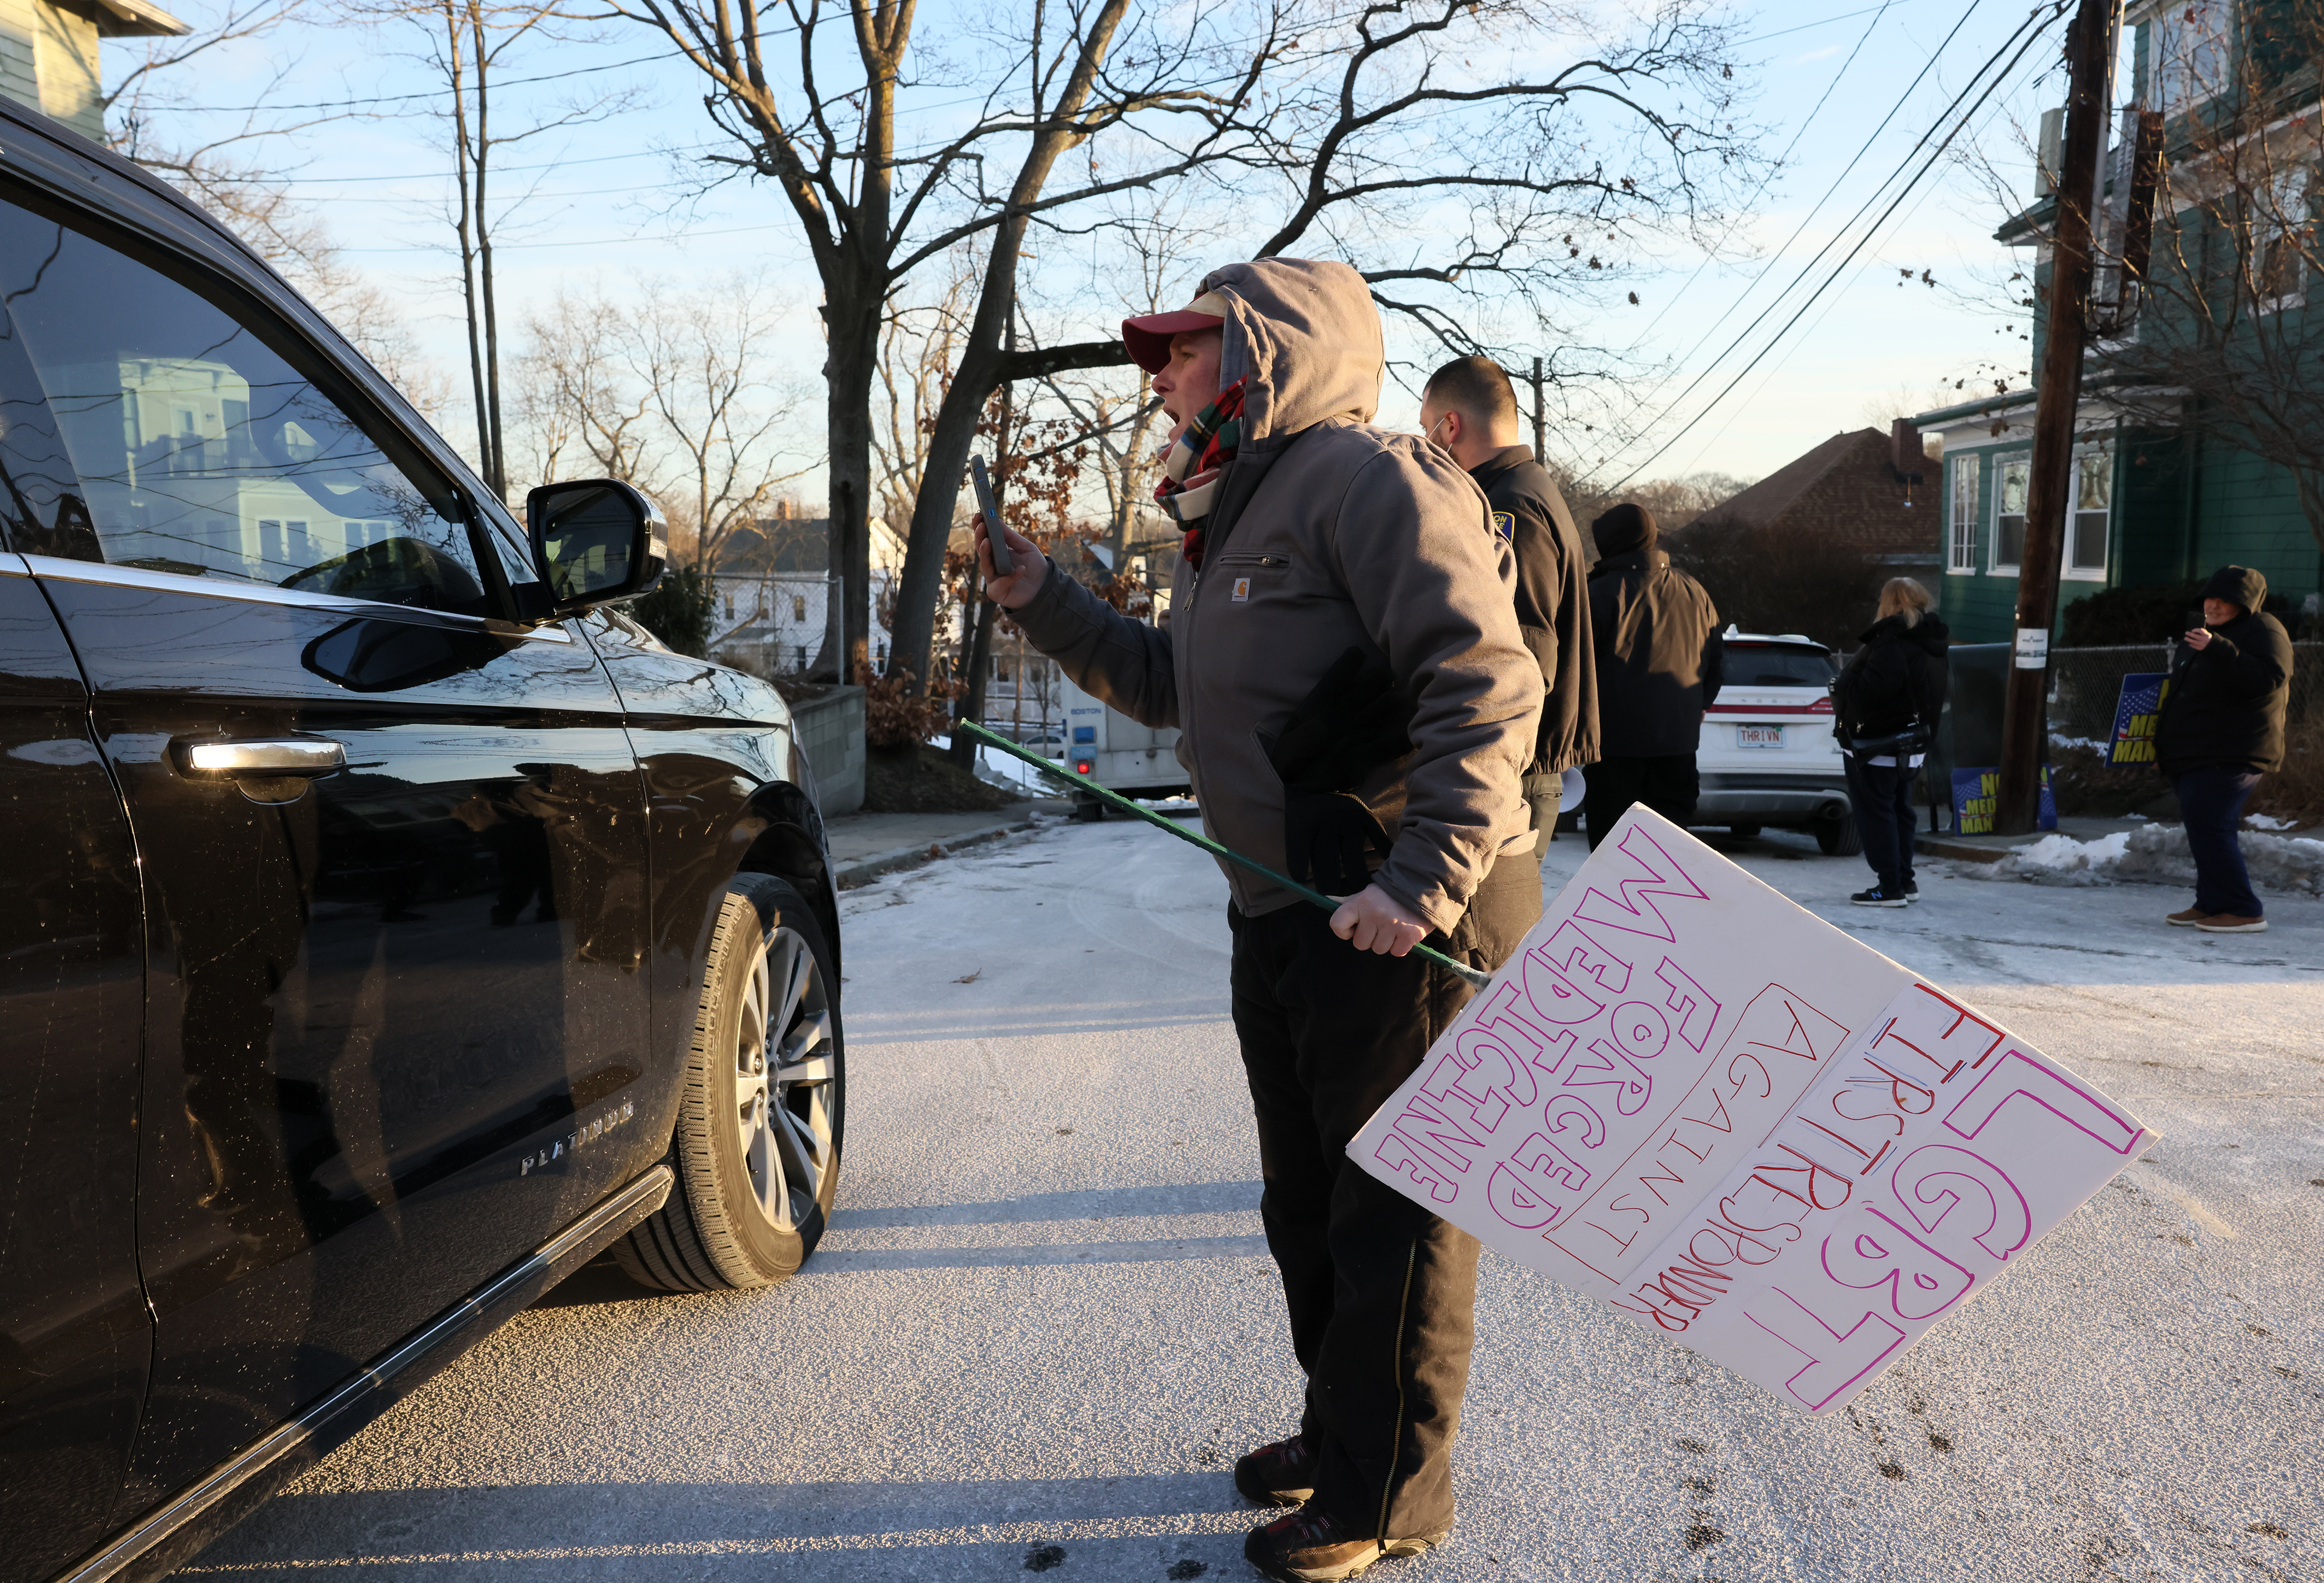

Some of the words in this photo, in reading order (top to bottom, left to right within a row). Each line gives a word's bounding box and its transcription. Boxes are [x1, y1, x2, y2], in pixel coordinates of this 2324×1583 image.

[1741, 730, 1779, 741] THRIVN
[1966, 798, 1996, 815] MED
[1374, 824, 1709, 1202] MEDICINE
[1488, 957, 1721, 1229] FORCED
[1797, 983, 2005, 1176] FIRST
[521, 1102, 634, 1176] PLATINUM
[1584, 1000, 1816, 1257] AGAINST
[1610, 1144, 1853, 1332] RESPONDER
[1744, 1050, 2145, 1410] LGBT
